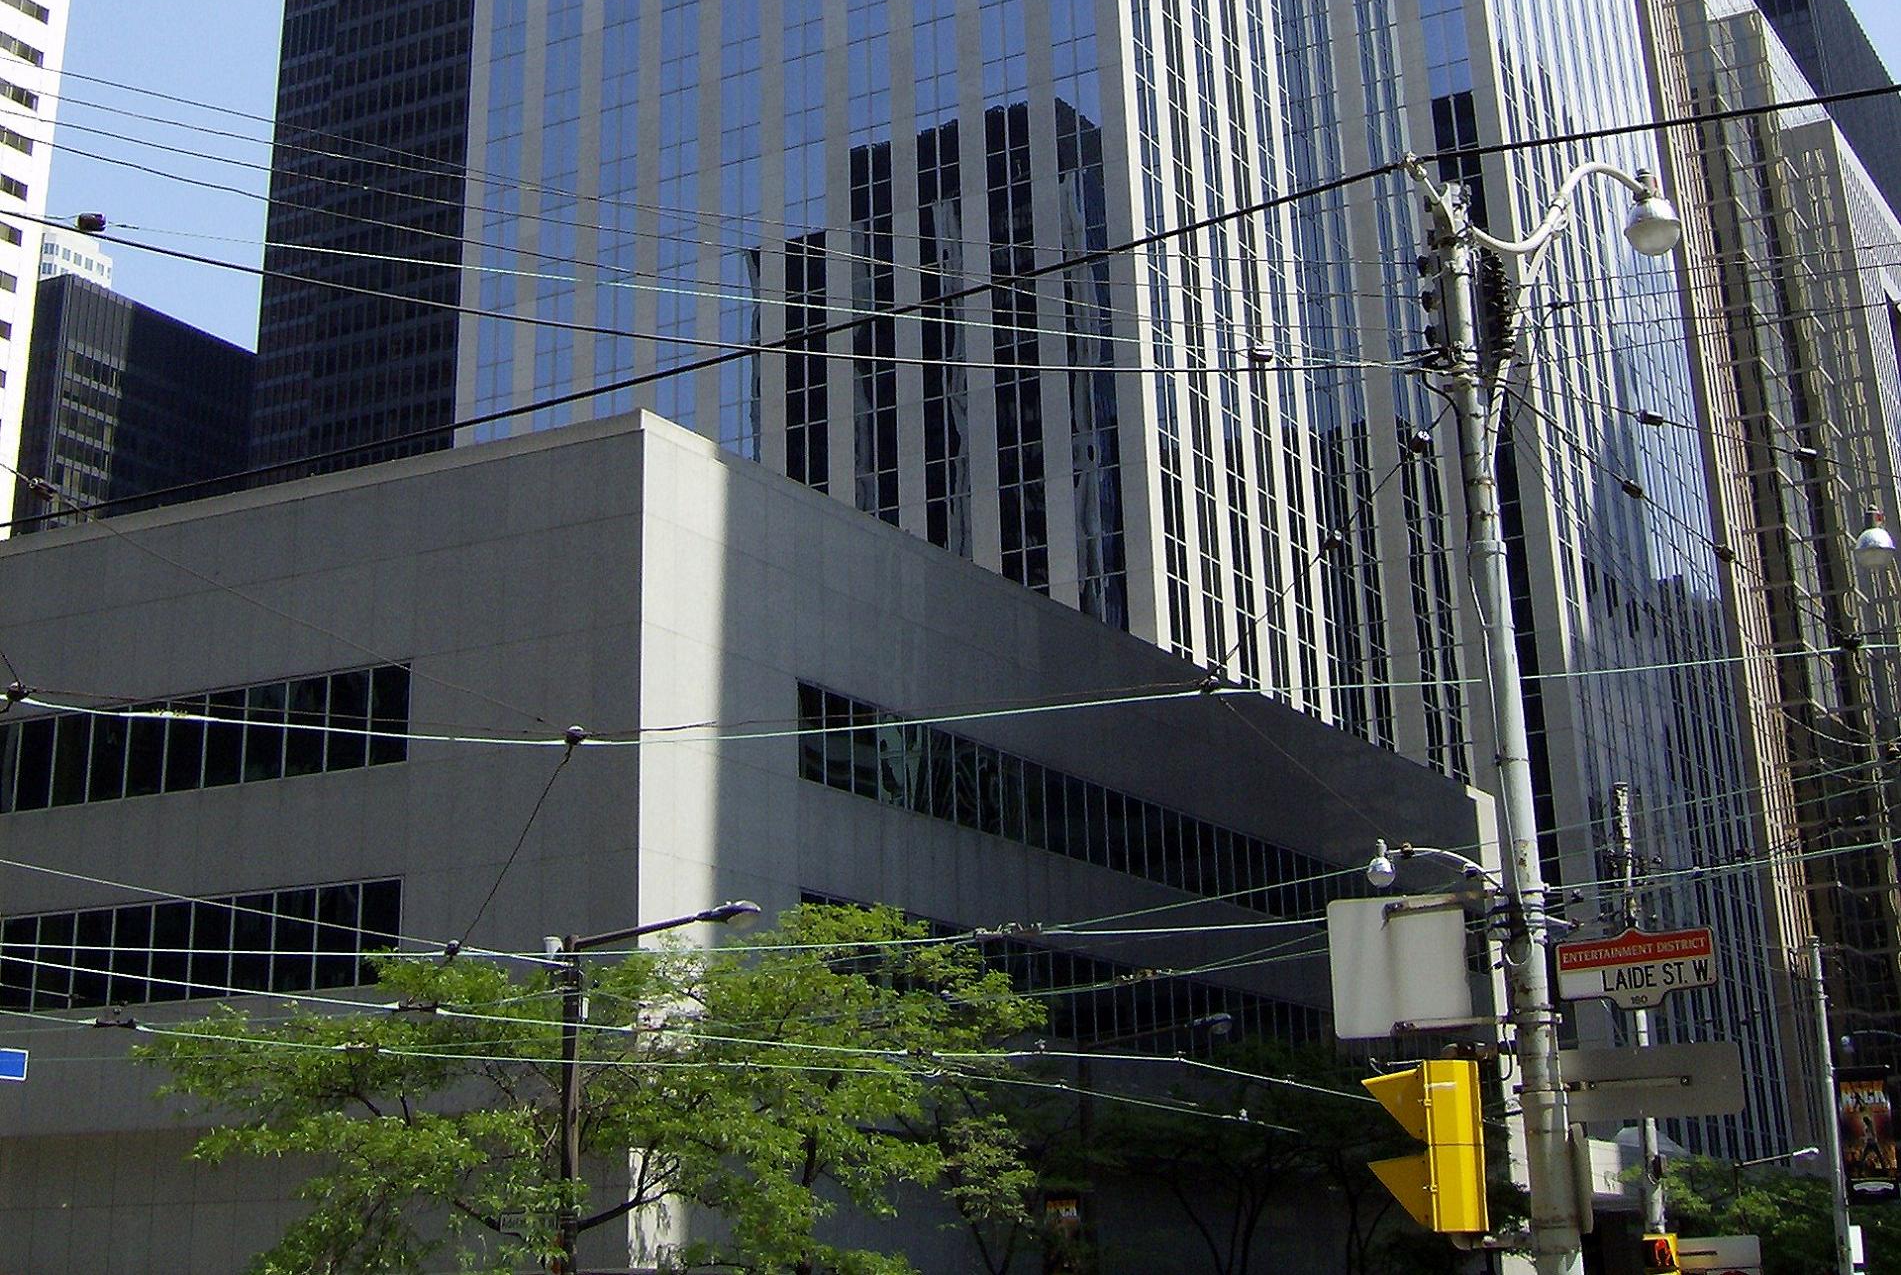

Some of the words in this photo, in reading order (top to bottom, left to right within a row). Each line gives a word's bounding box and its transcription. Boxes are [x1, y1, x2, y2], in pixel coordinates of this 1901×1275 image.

[1563, 943, 1653, 963] ENTERTAINMENT
[1657, 937, 1705, 952] DISTRICT
[1663, 961, 1688, 985] ST.
[1692, 959, 1712, 982] W.
